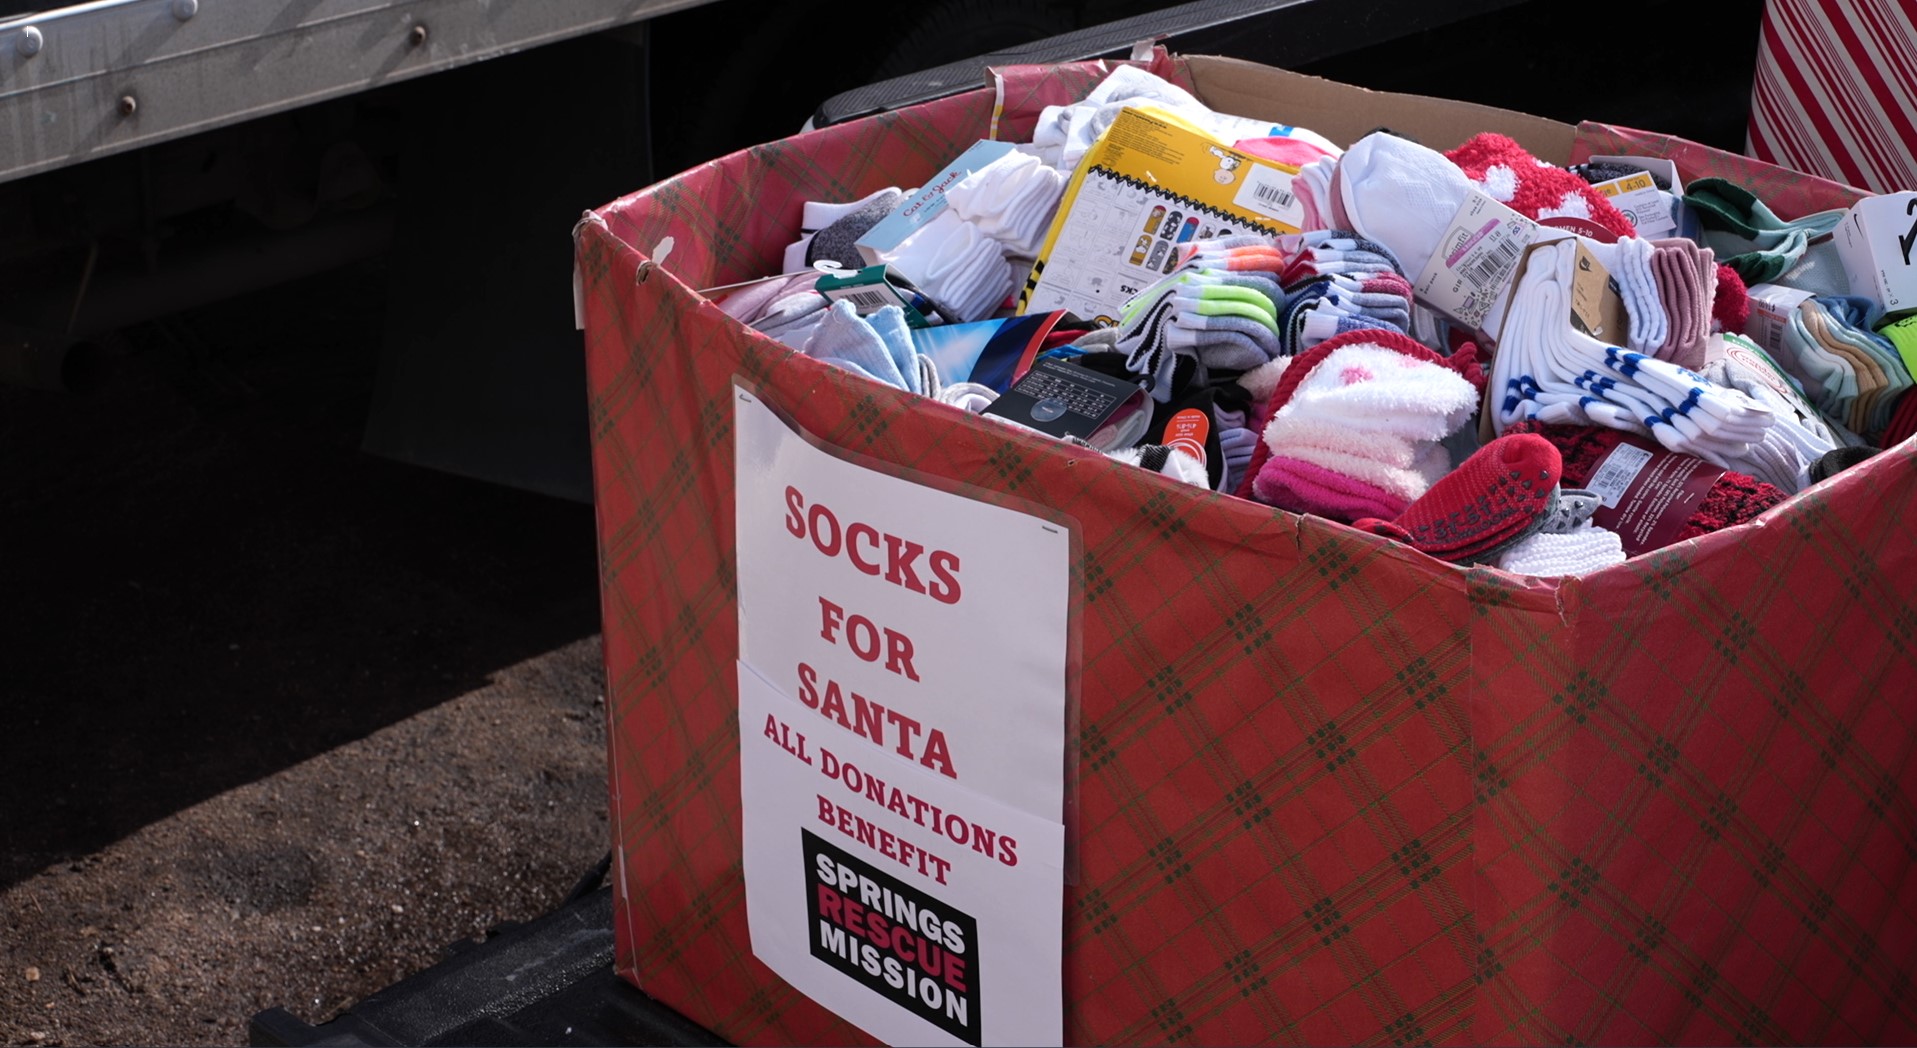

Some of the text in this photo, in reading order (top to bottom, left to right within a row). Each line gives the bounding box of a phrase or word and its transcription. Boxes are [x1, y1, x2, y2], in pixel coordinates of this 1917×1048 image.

[903, 202, 924, 217] Cat
[932, 171, 962, 194] Jack
[1578, 227, 1594, 238] 5-10
[1626, 179, 1646, 192] 4-10
[785, 486, 962, 604] SOCKS
[818, 596, 920, 682] FOR
[798, 662, 957, 780] SANTA
[764, 712, 1018, 867] ALL DONATIONS
[816, 794, 950, 886] BENEFIT
[816, 853, 965, 954] SPRINGS
[818, 882, 966, 994] RESCUE
[820, 918, 968, 1027] MISSION
